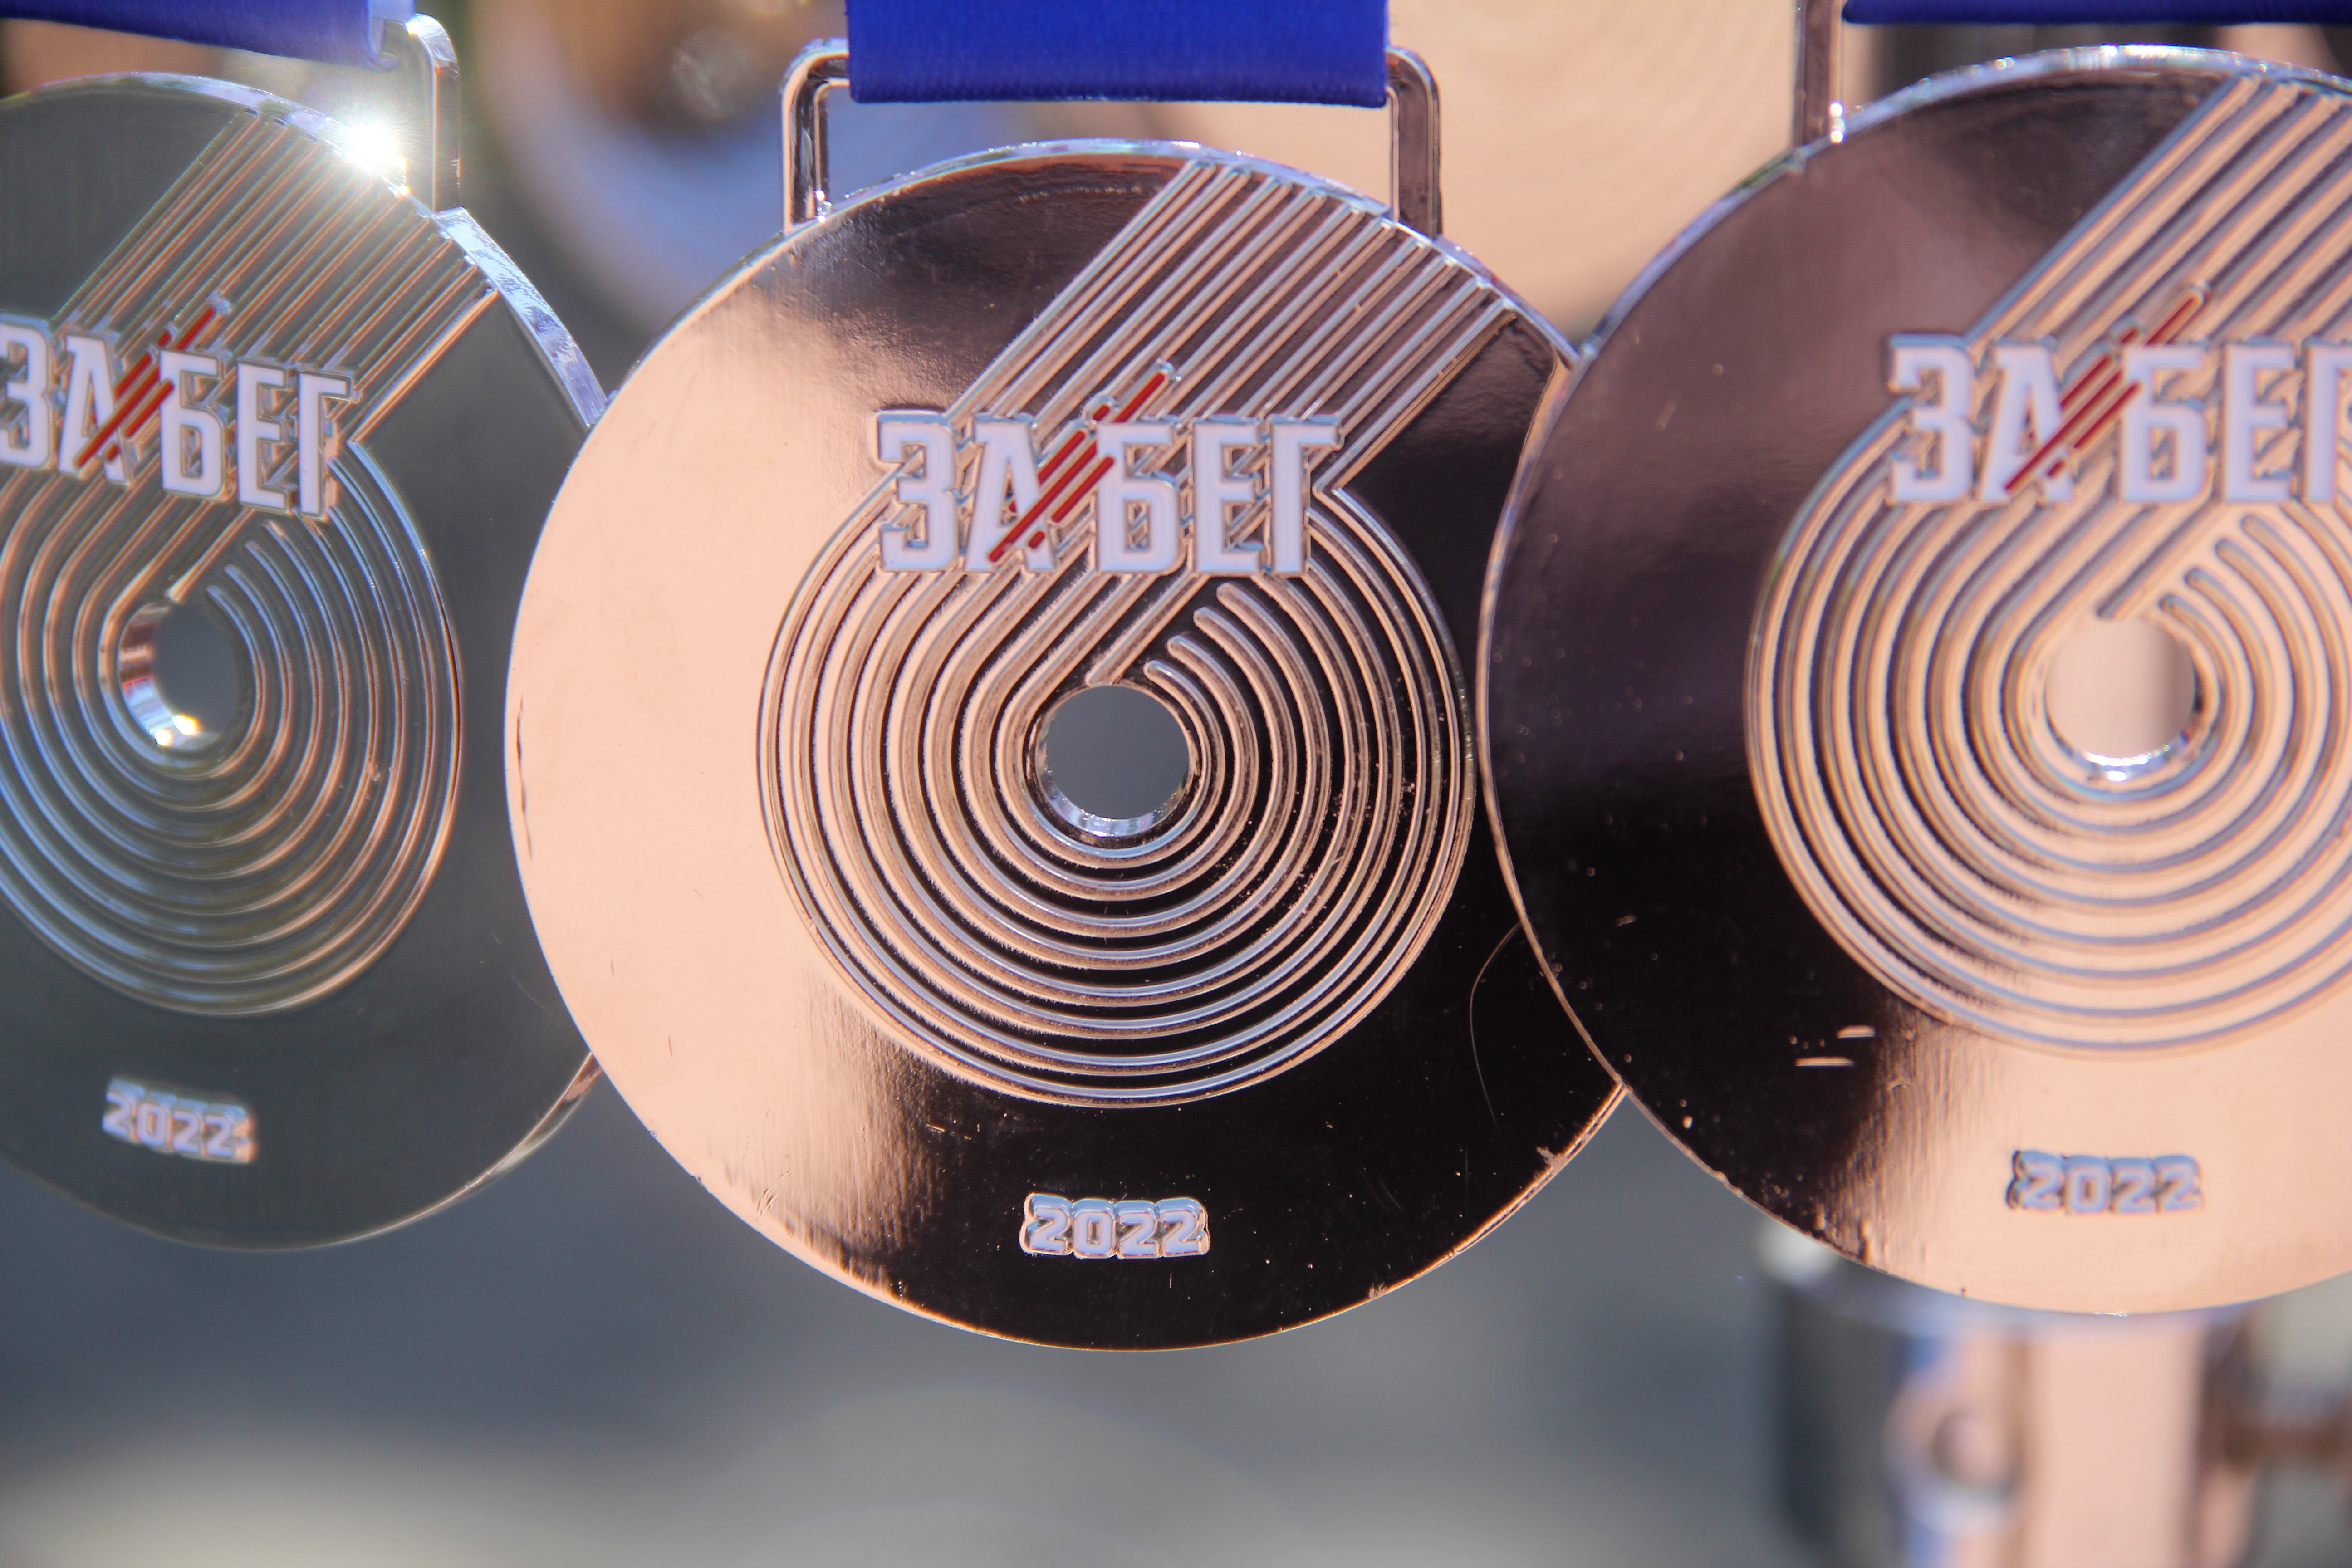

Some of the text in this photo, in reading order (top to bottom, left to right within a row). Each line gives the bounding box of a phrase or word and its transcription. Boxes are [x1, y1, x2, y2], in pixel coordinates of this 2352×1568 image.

[0, 321, 350, 516] ЗАБЕГ
[877, 414, 1339, 573] ЗАБЕГ
[102, 1085, 243, 1160] 2022
[2012, 1158, 2200, 1214] 2022
[1024, 1200, 1205, 1257] 2022
